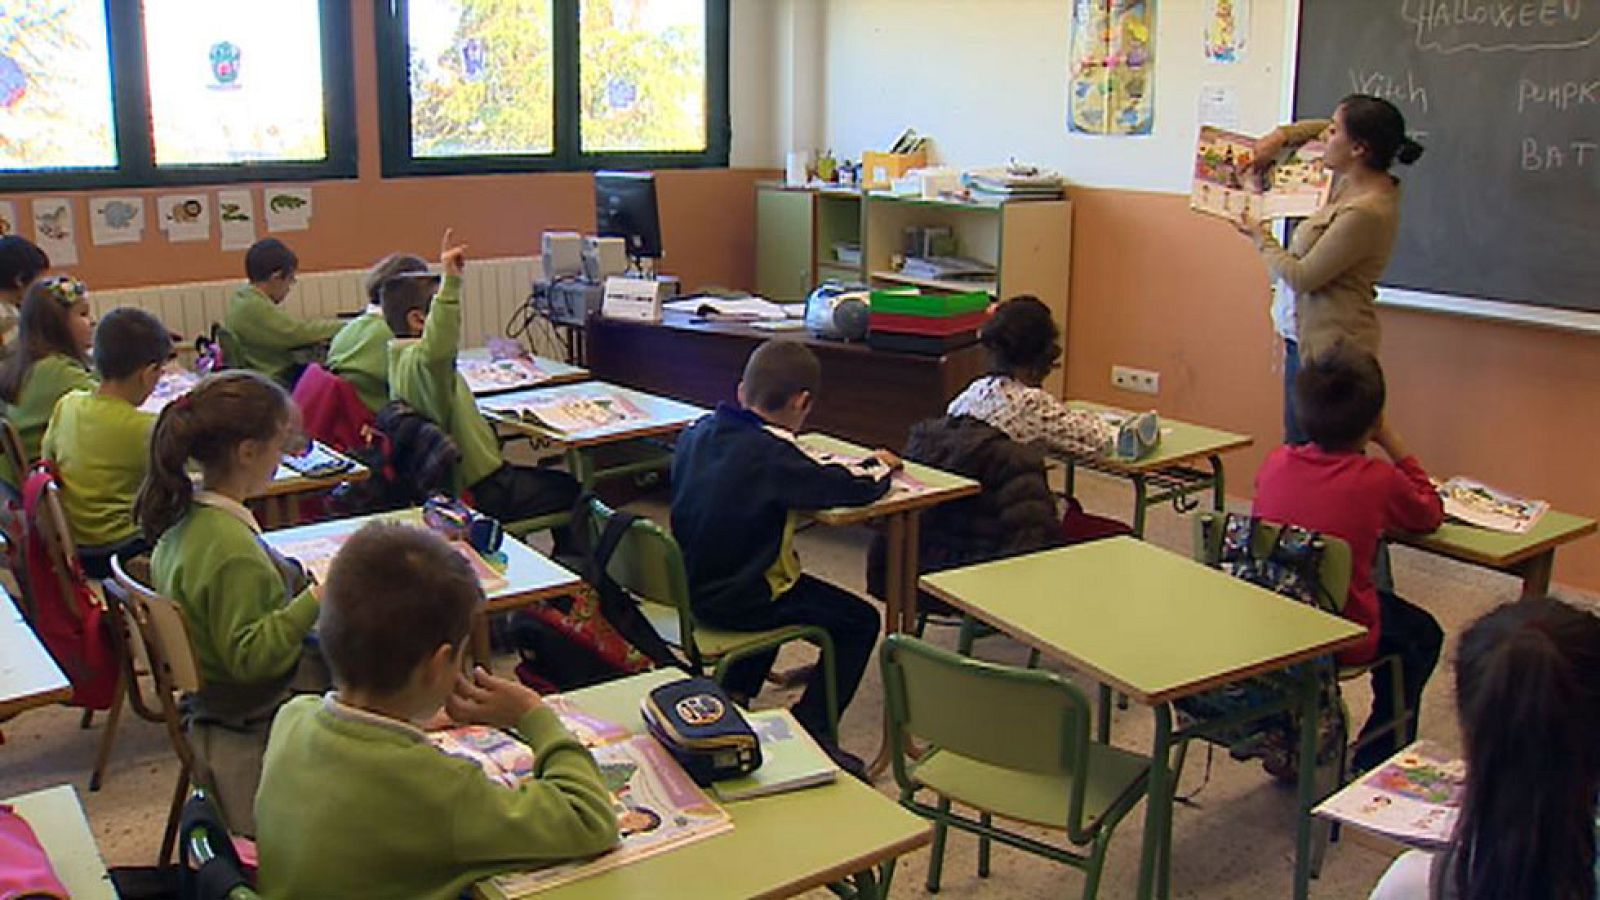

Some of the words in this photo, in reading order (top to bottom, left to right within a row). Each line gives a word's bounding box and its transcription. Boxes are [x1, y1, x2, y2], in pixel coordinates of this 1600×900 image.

[1417, 0, 1581, 31] HALLOWEEN
[1349, 67, 1428, 114] Witch
[1521, 137, 1599, 171] BAT
